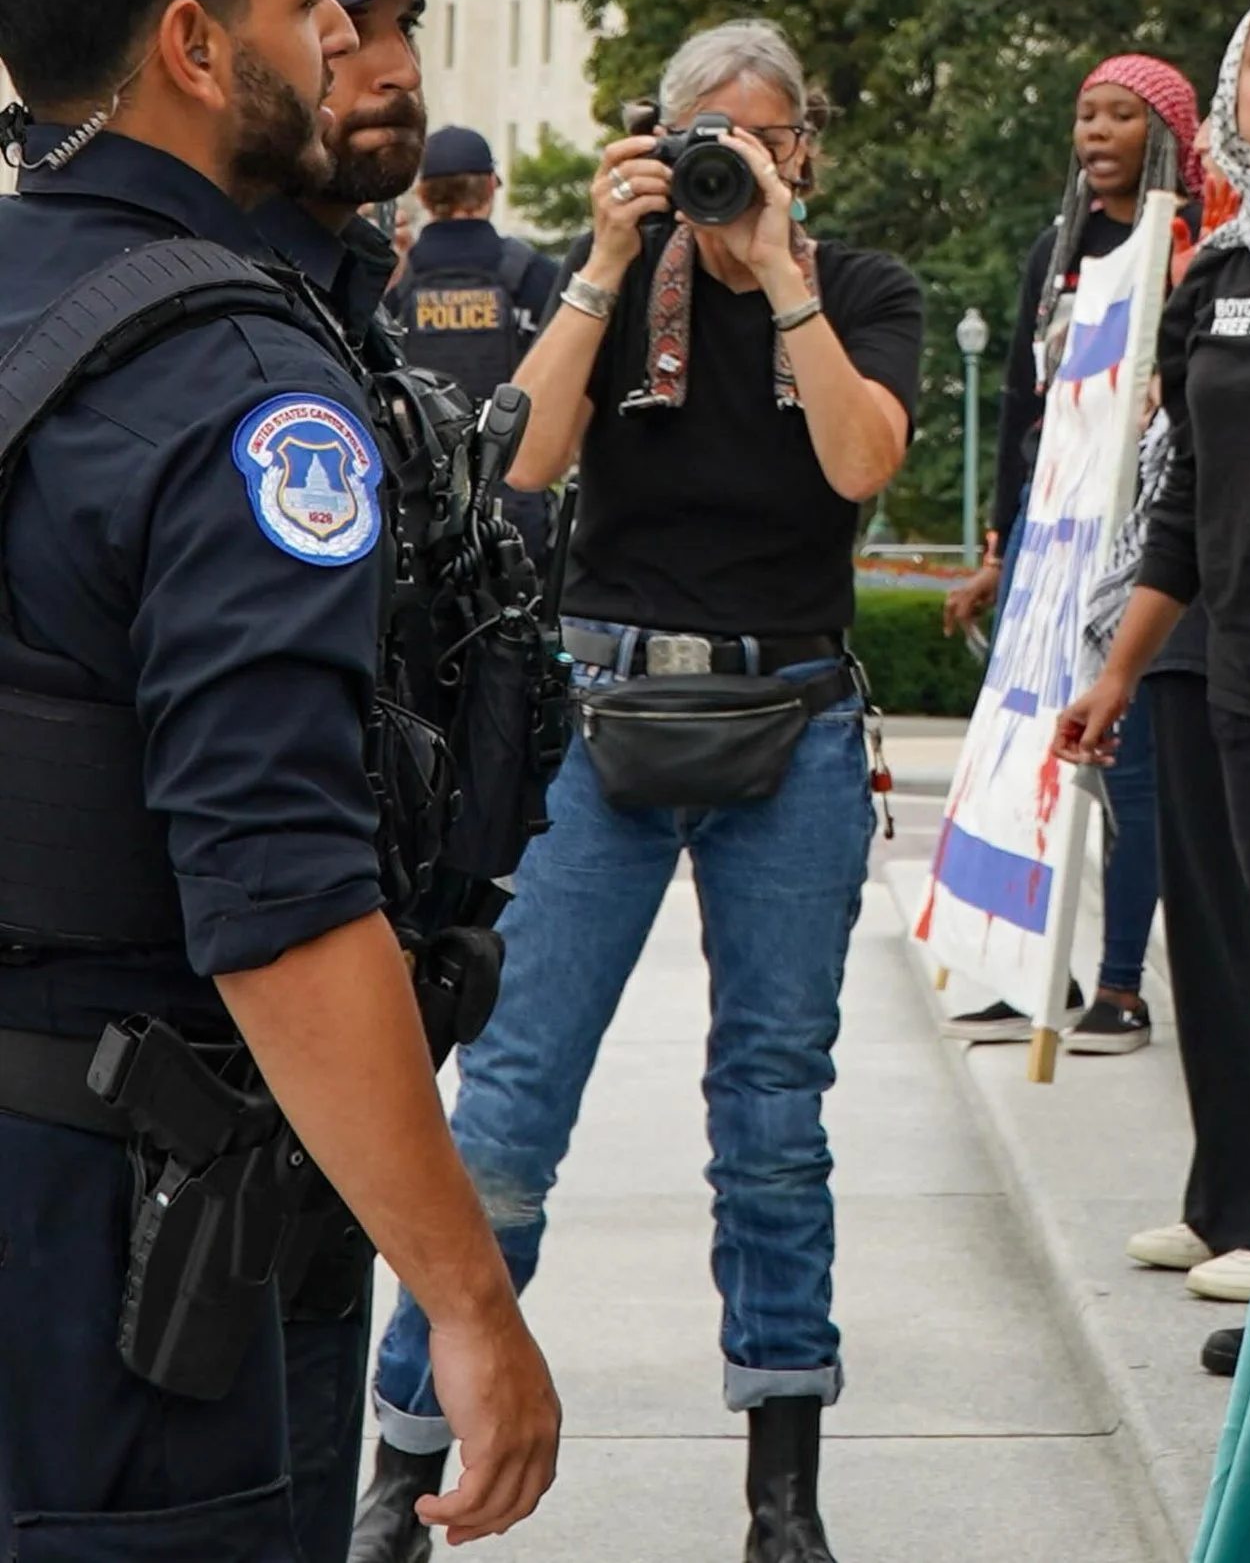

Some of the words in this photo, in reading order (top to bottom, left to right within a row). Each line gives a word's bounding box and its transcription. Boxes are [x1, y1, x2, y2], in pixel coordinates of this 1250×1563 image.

[416, 304, 498, 330] POLICE
[272, 407, 308, 428] STATES
[308, 511, 333, 525] 1828
